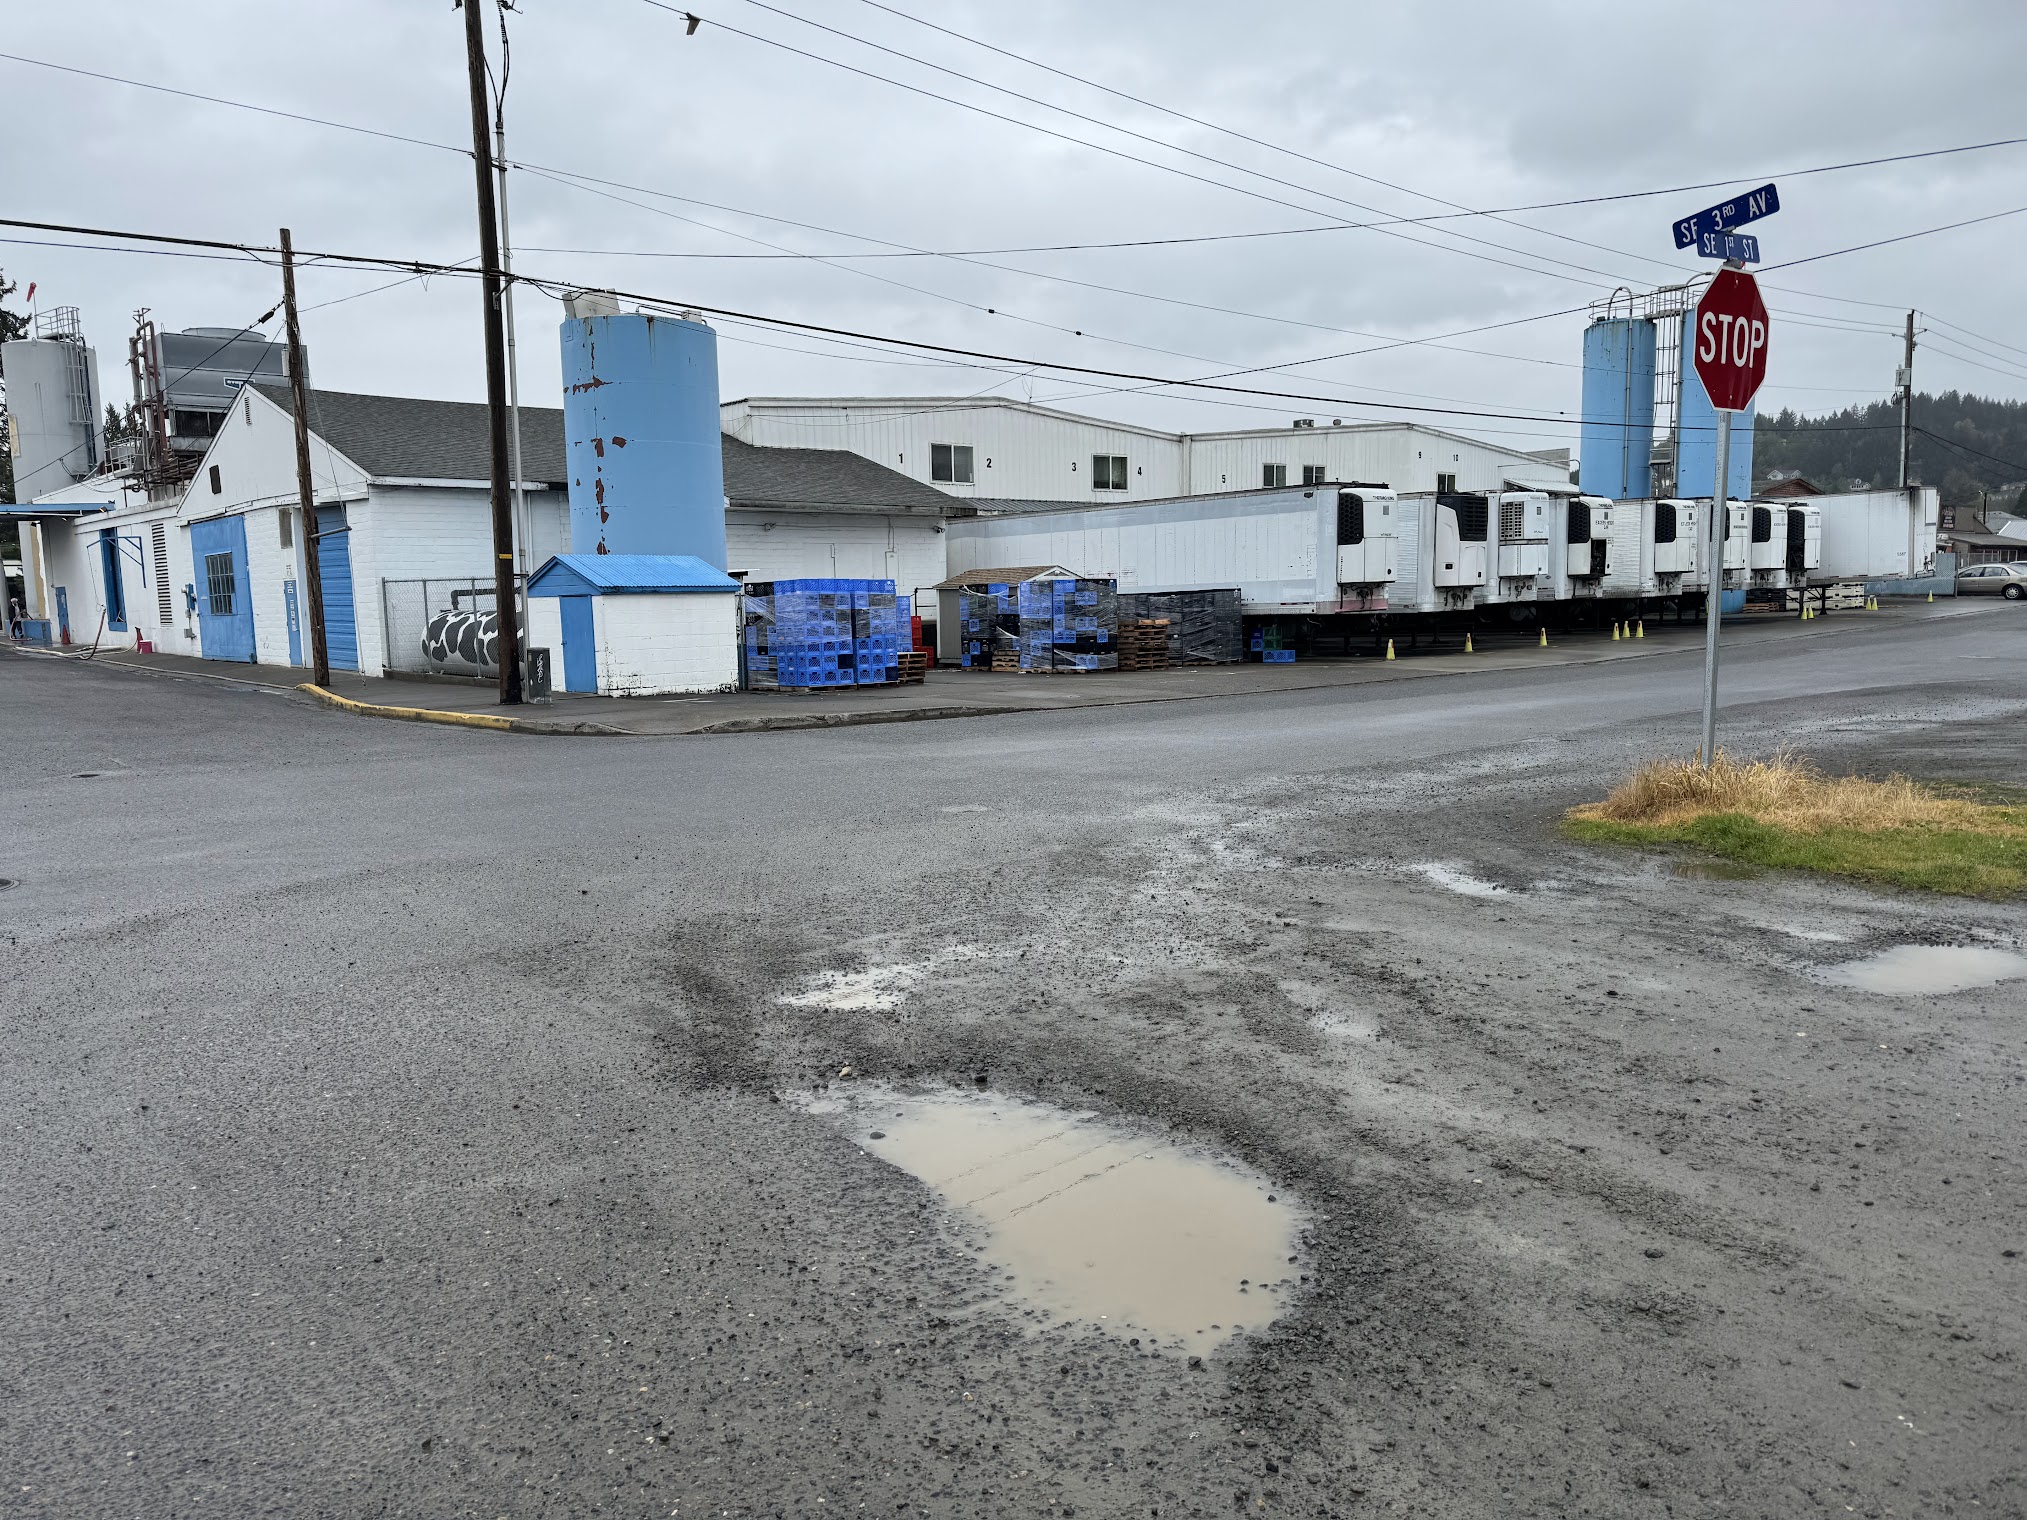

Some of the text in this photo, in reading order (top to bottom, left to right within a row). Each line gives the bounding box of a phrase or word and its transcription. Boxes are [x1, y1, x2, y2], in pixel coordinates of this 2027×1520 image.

[1712, 204, 1736, 231] 3RD
[1749, 191, 1767, 218] AV
[1703, 232, 1754, 259] SE 1ST ST
[1699, 311, 1764, 369] STOP
[986, 458, 992, 468] 2
[1071, 462, 1077, 472] 3
[1138, 466, 1143, 476] 4
[1221, 475, 1226, 484] 5
